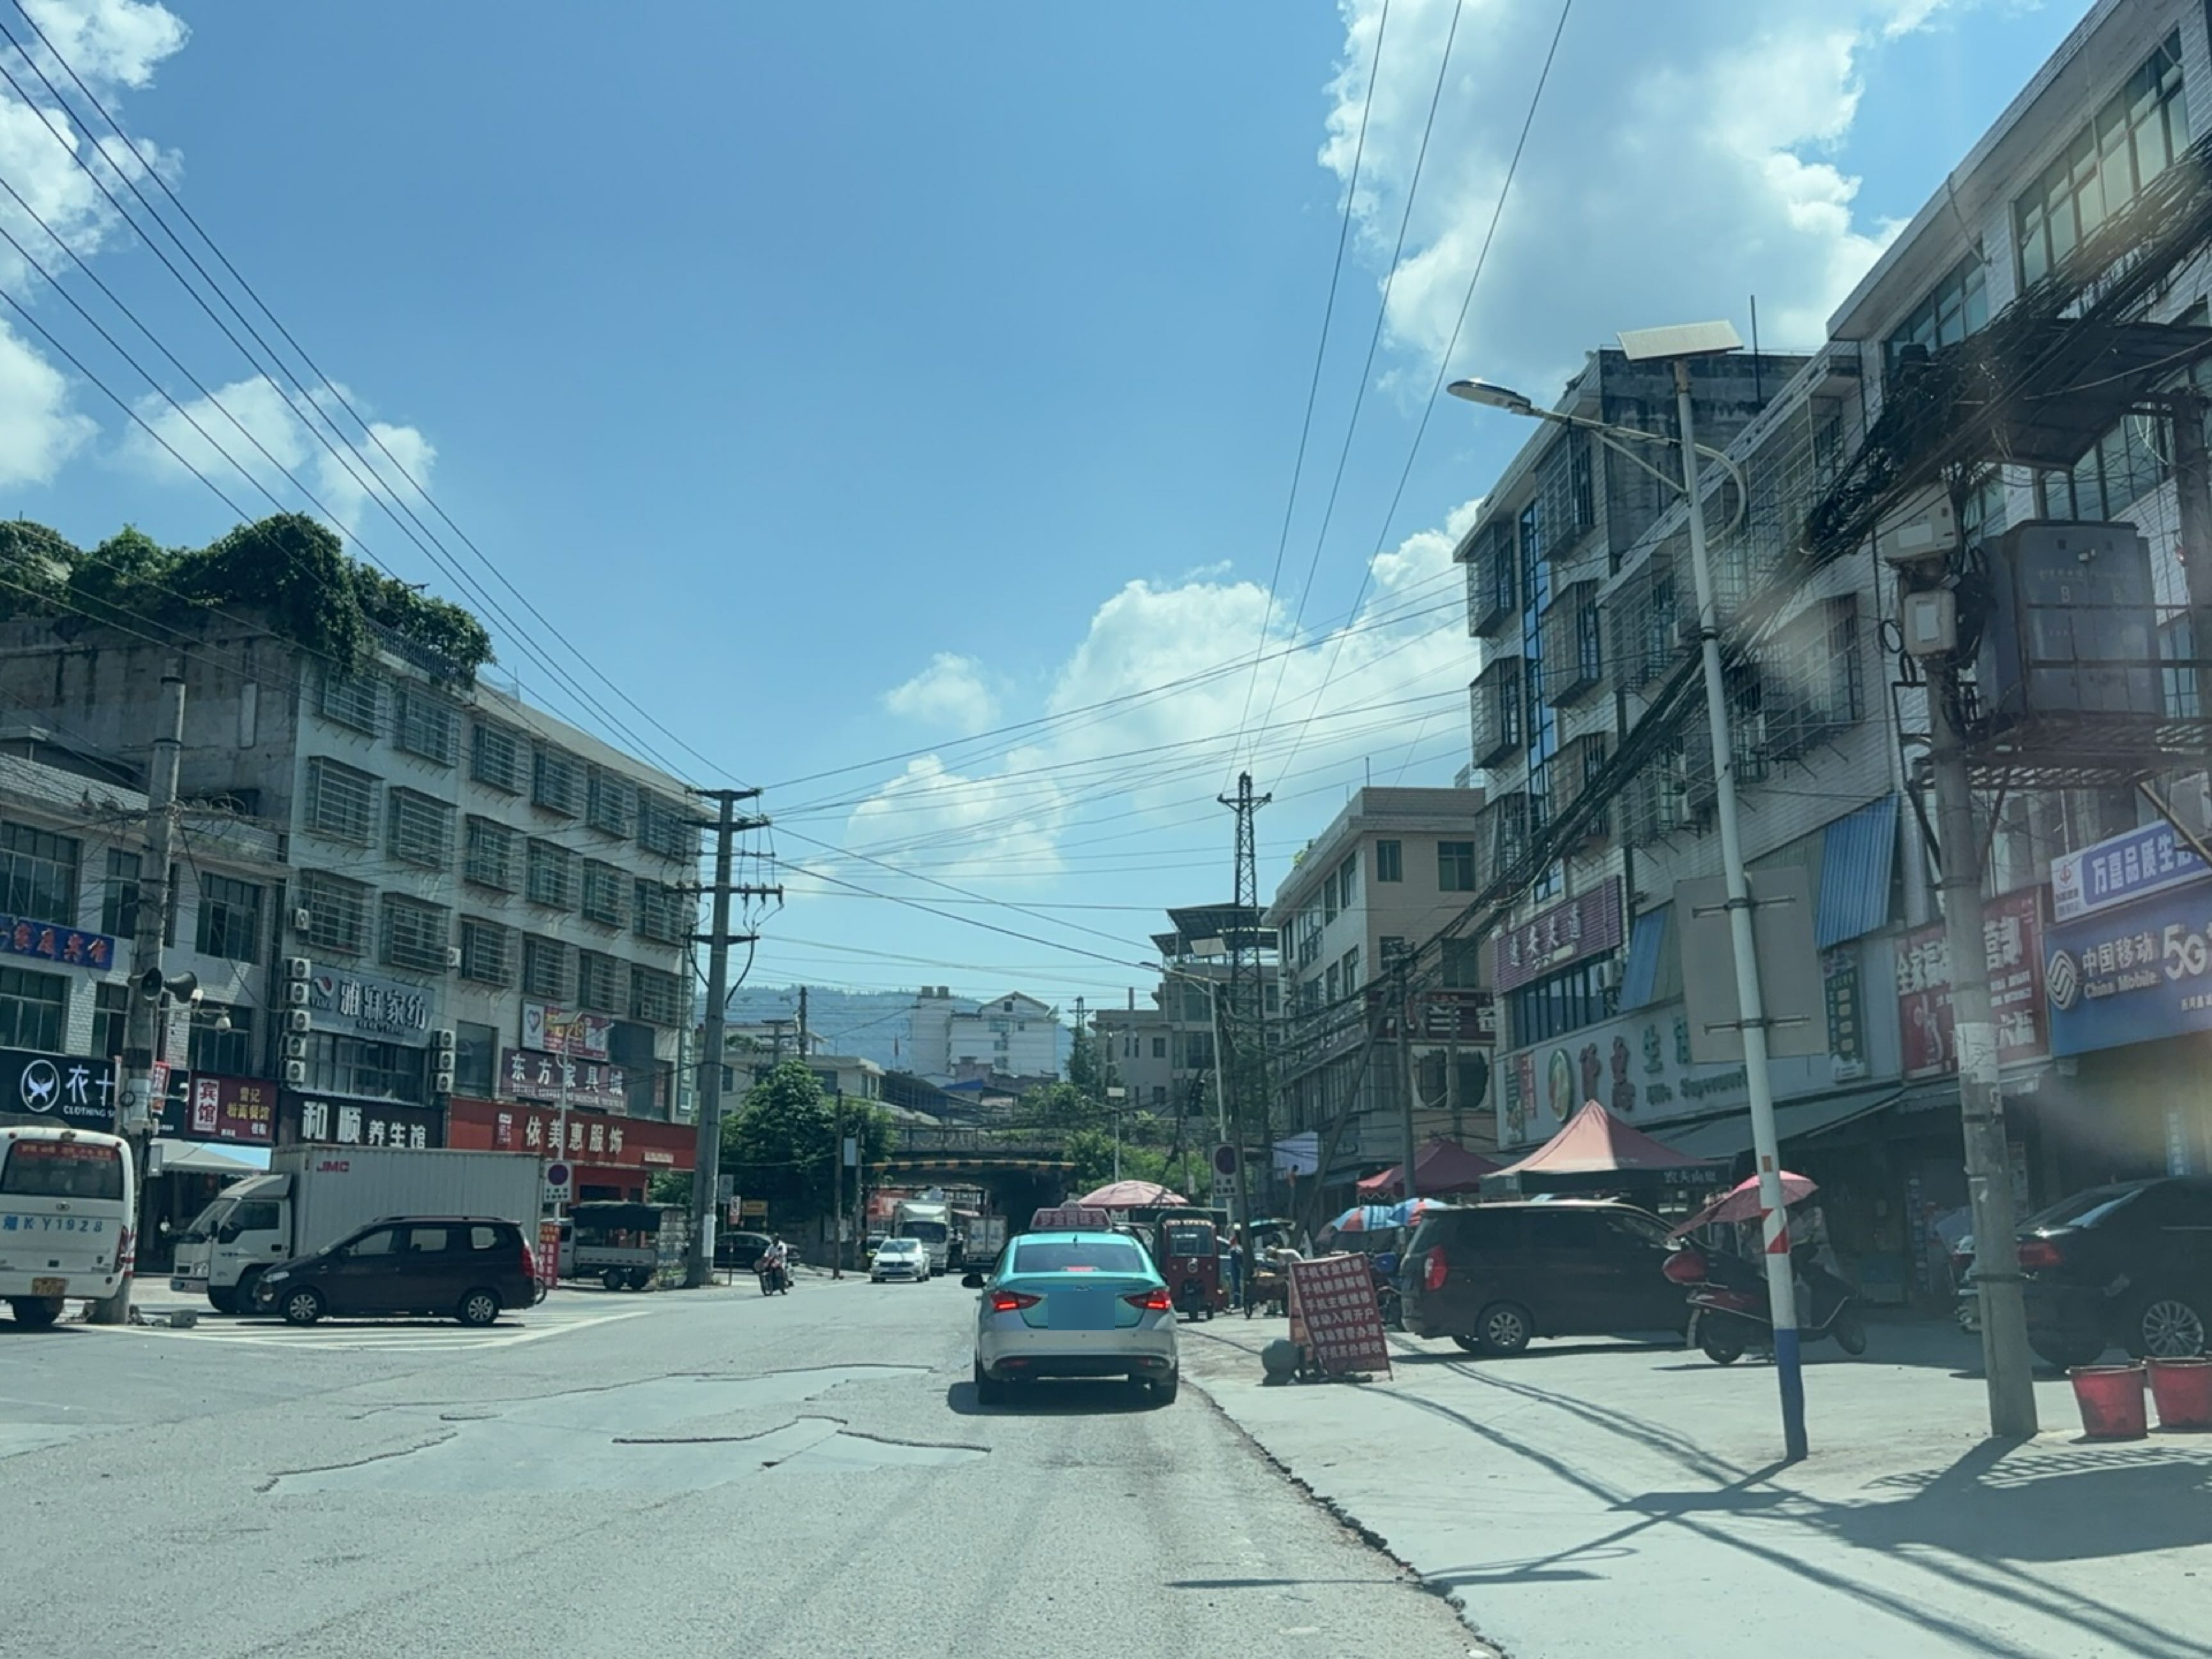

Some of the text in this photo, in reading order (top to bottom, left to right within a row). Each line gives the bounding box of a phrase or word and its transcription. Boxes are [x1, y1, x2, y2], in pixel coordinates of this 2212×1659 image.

[2083, 931, 2154, 978] 中国移动
[2163, 923, 2208, 980] 5G
[2084, 970, 2157, 999] China Mobile
[512, 1054, 623, 1096] 东方家具城
[197, 1081, 219, 1123] 宾馆
[302, 1100, 426, 1150] 和顺养生馆
[316, 1160, 350, 1173] JMC
